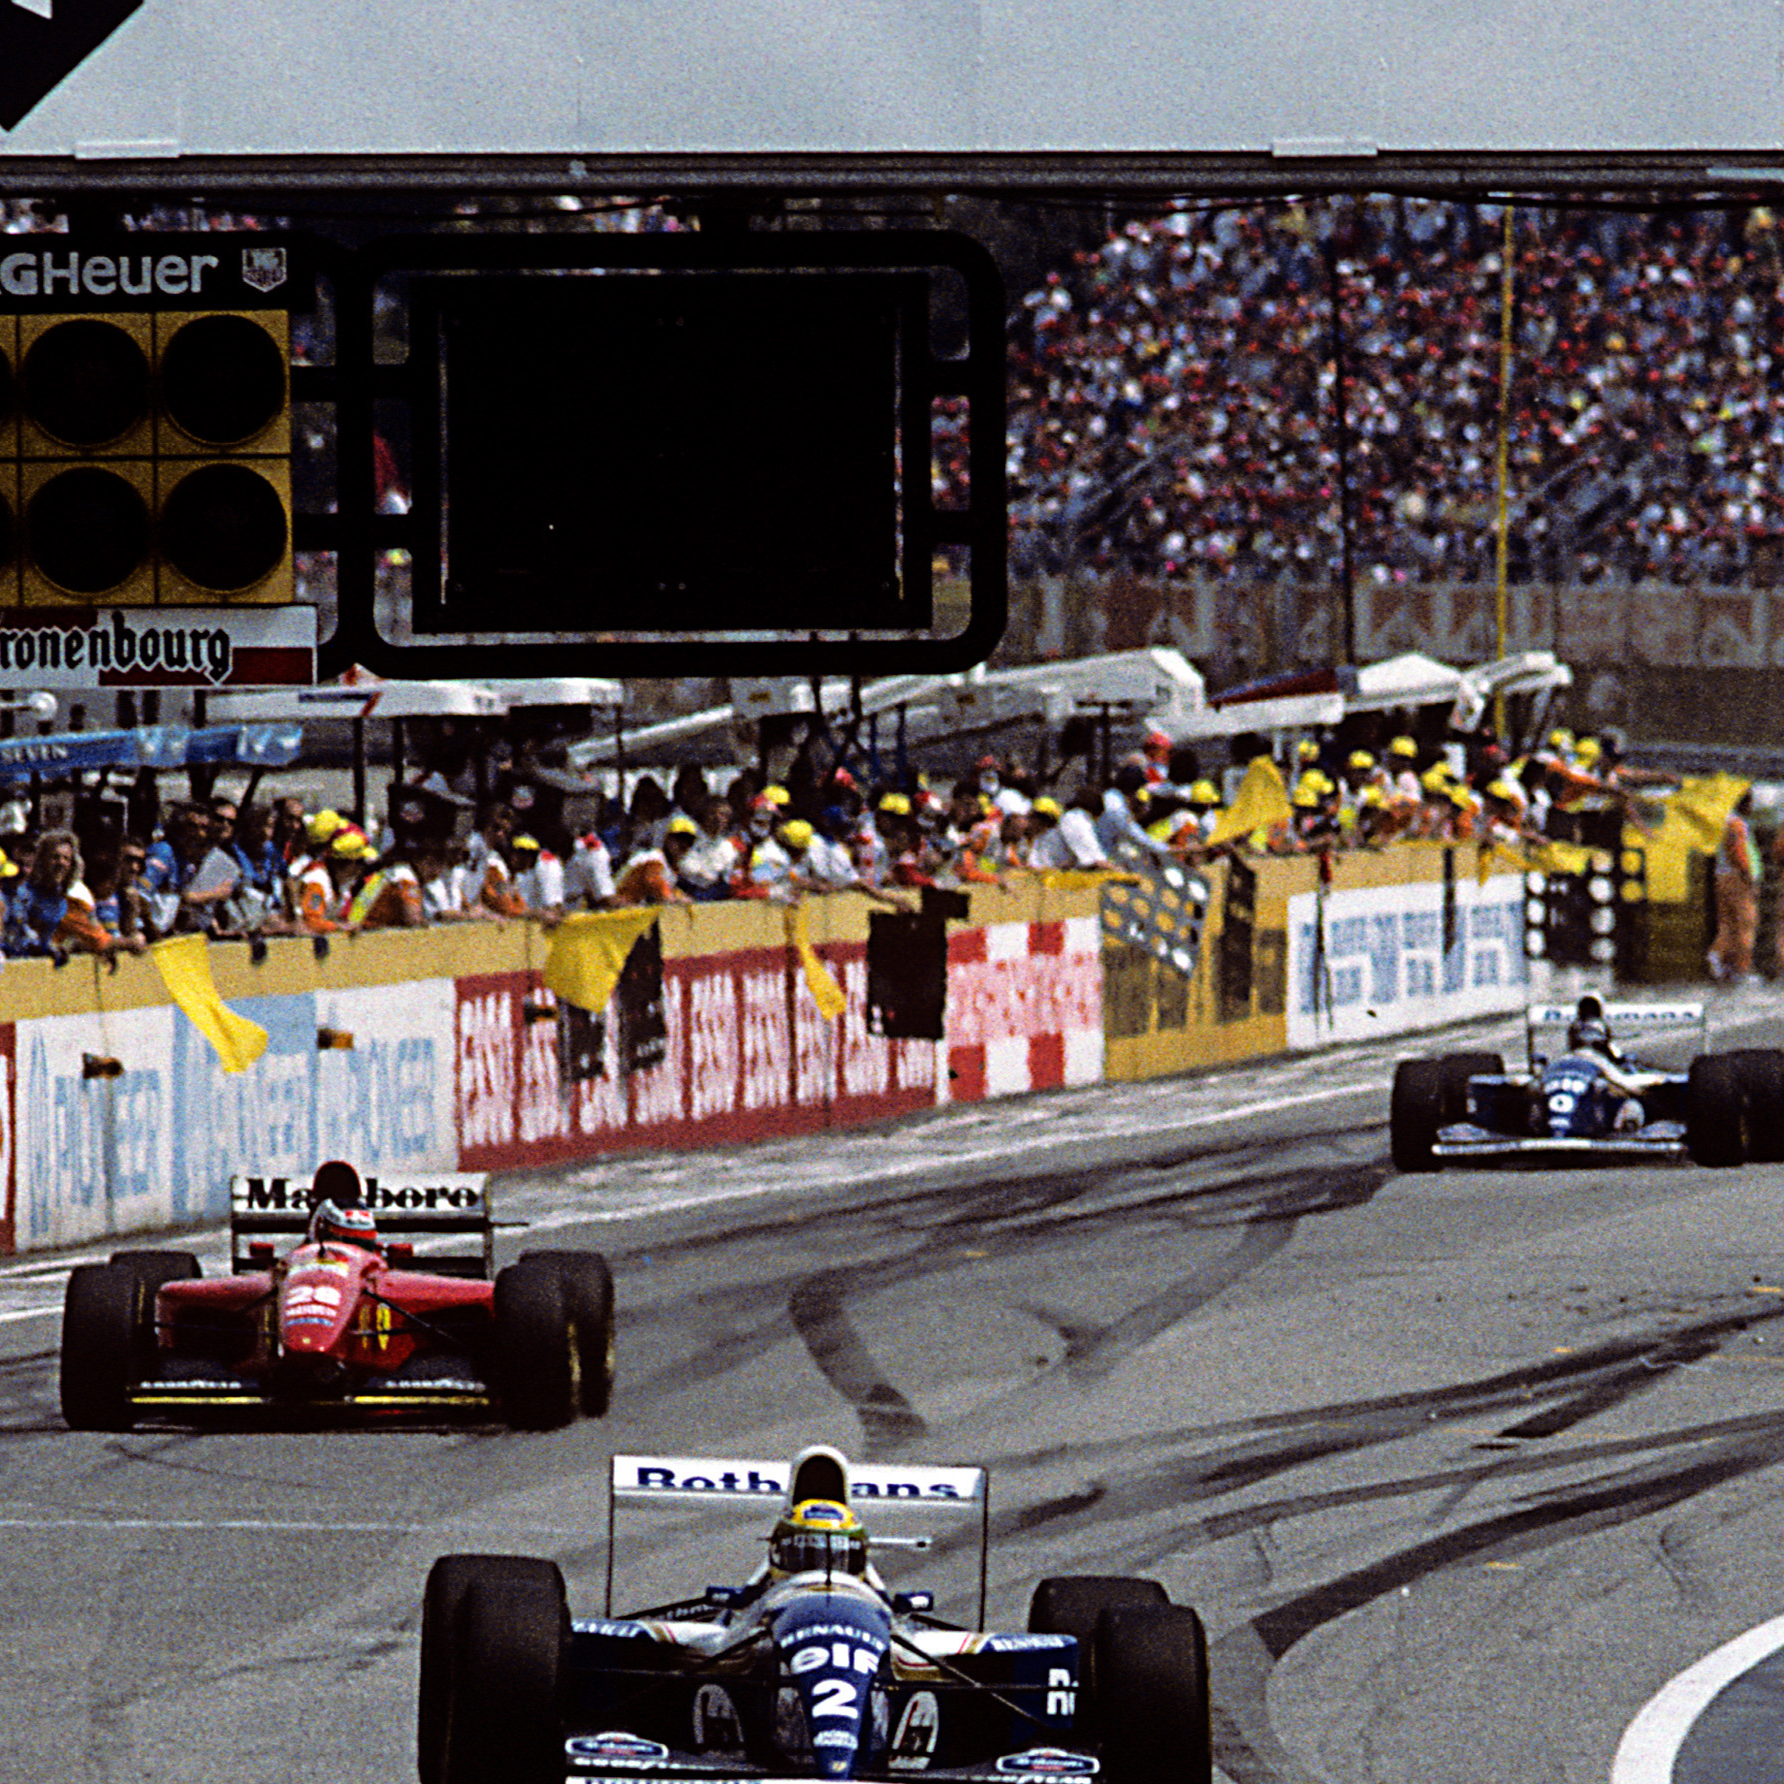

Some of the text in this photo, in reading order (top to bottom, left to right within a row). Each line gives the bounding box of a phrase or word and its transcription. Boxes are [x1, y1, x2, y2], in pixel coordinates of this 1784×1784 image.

[246, 1178, 479, 1209] Maboro
[637, 1466, 961, 1499] Rothans
[811, 1678, 859, 1720] 2
